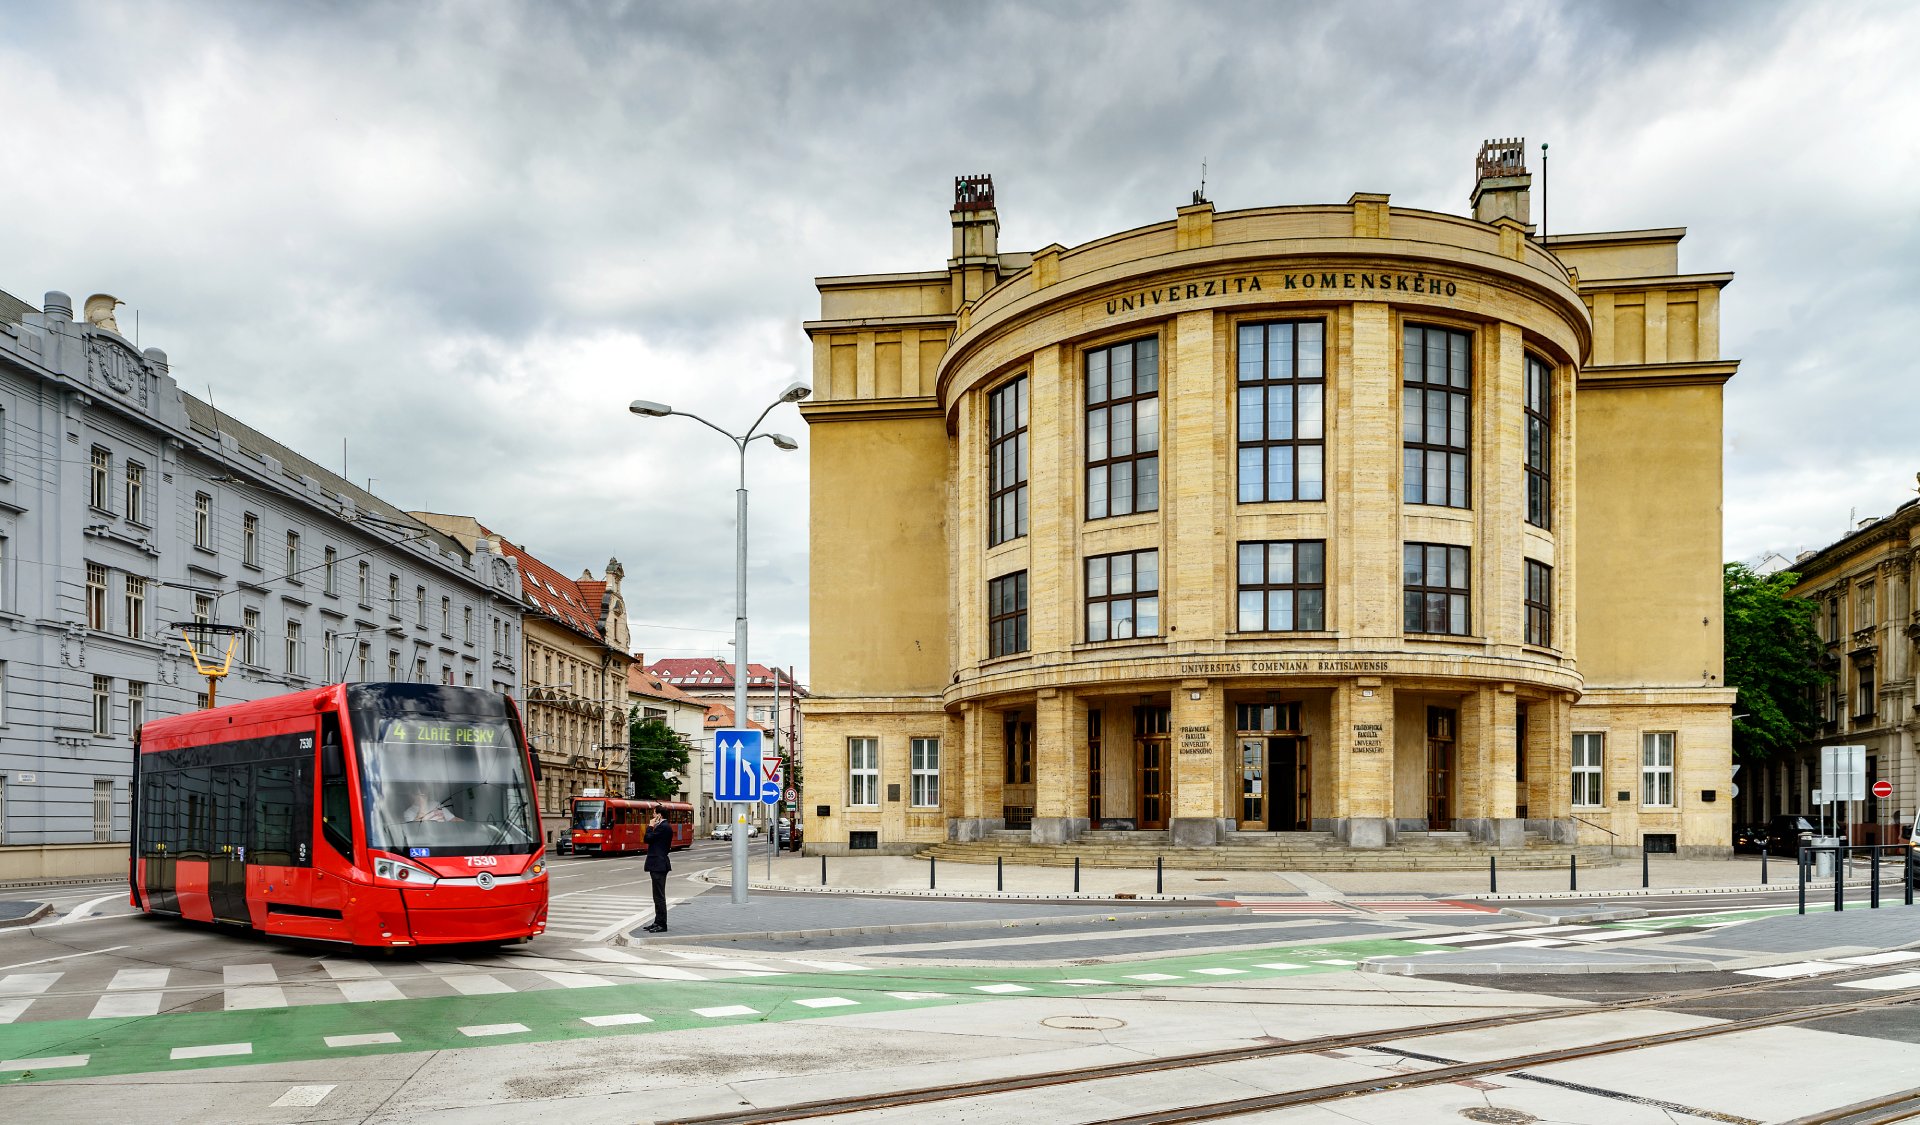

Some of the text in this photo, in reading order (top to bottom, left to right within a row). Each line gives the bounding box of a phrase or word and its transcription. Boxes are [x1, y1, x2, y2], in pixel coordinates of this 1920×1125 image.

[1106, 271, 1457, 315] UNIVERZITA KOMENSKÉHO
[1181, 661, 1388, 673] UNIVERSITAS COMENIANA BRATISLAVENSIS
[393, 723, 406, 740] 4
[456, 728, 494, 743] PIESKY
[299, 737, 313, 749] 7530
[463, 855, 498, 867] 7530
